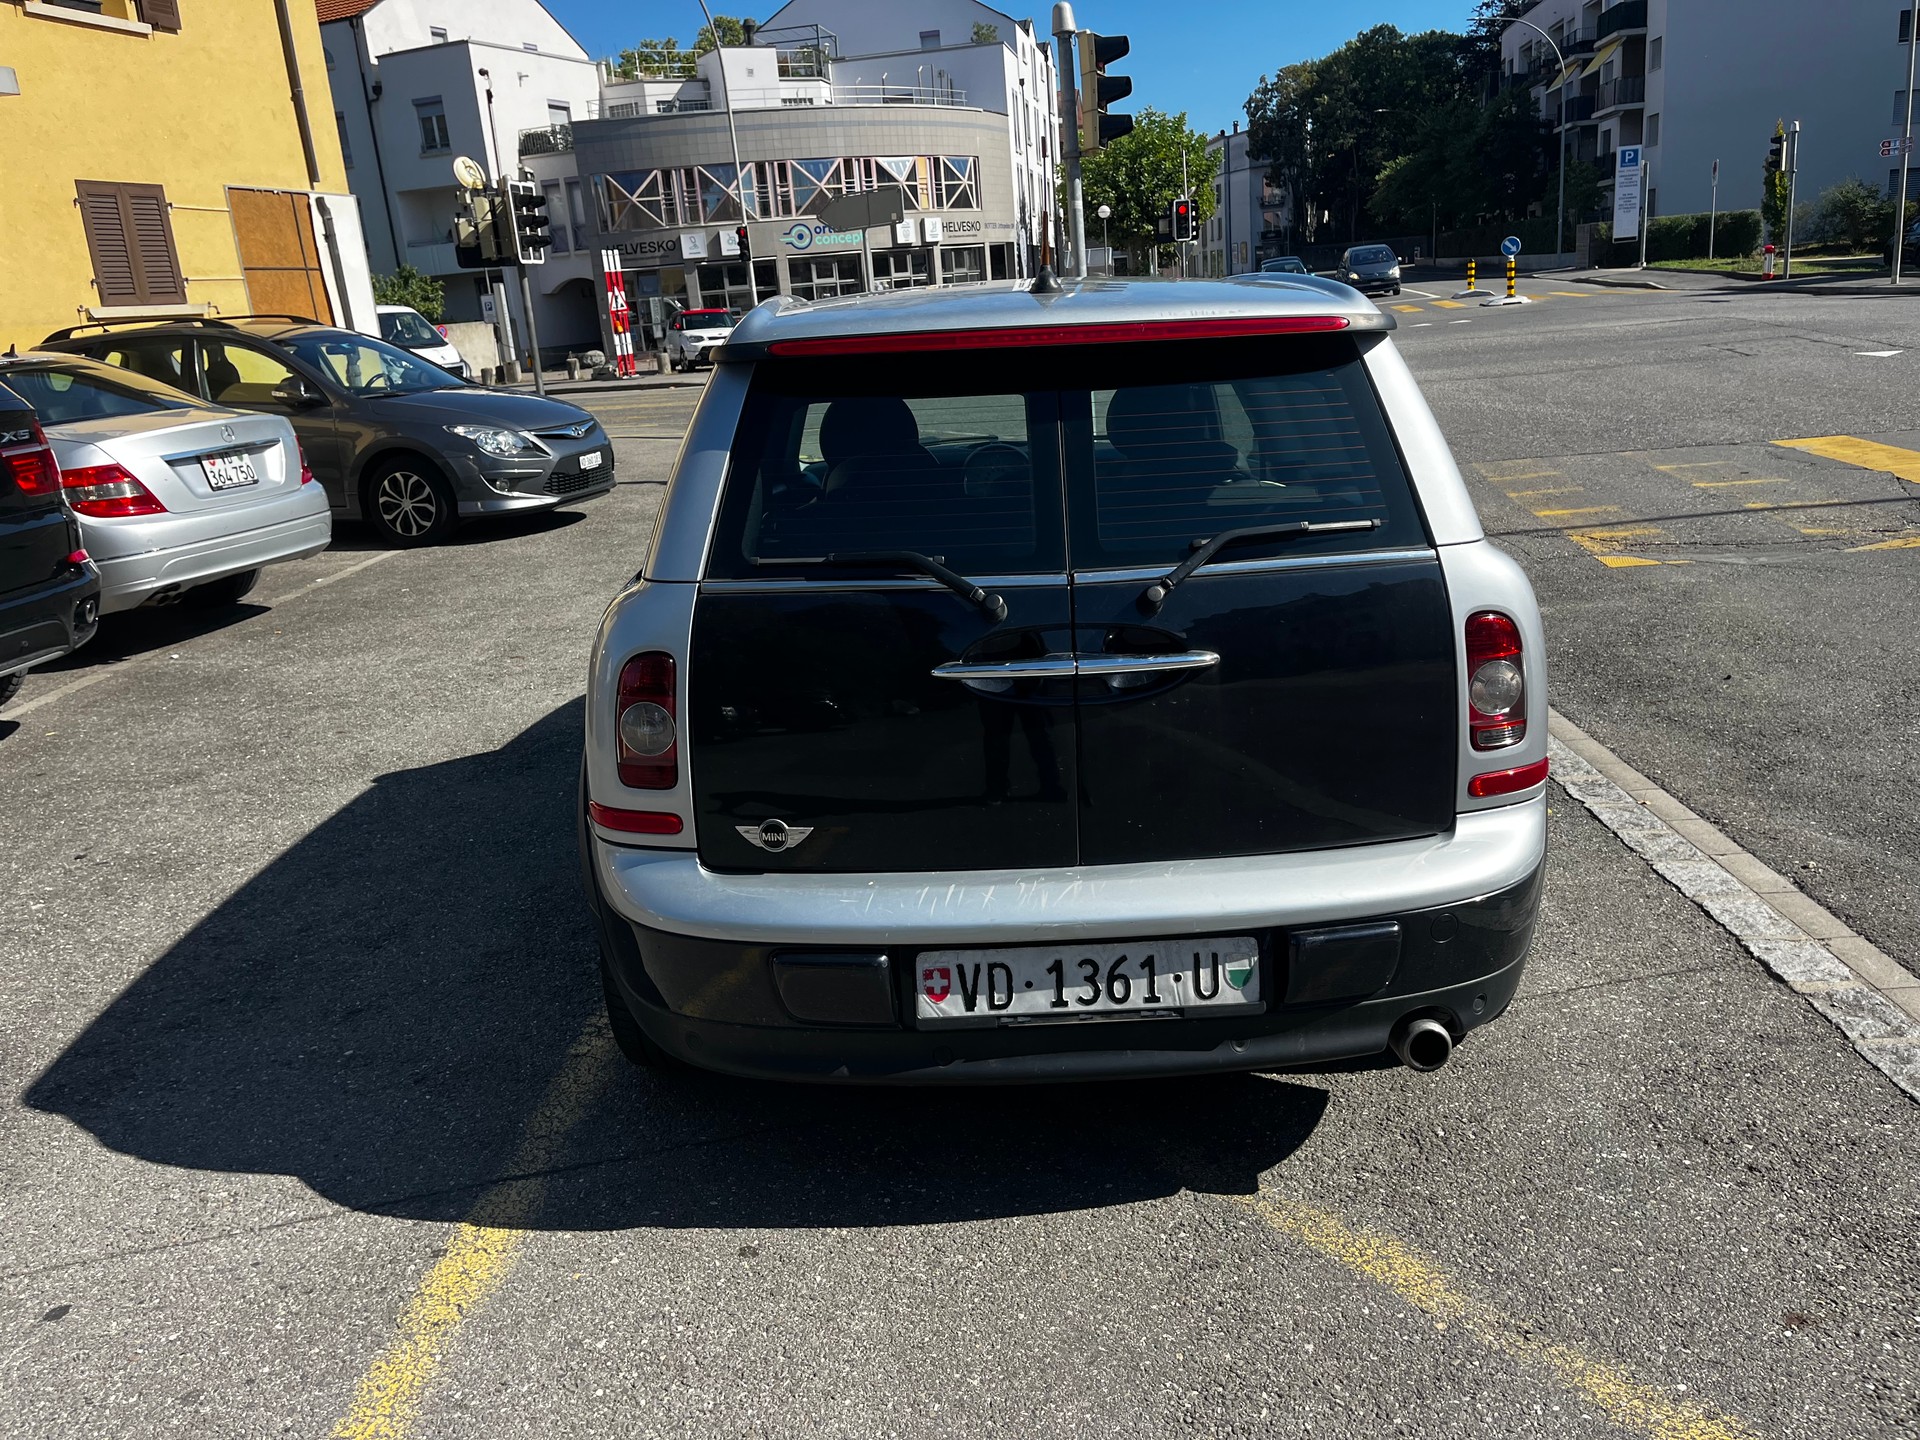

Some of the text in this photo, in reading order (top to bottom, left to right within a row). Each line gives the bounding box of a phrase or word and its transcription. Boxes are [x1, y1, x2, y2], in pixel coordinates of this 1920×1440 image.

[1625, 151, 1635, 163] P
[942, 221, 981, 232] HELVESKO
[0, 429, 30, 443] X5
[210, 465, 254, 485] 364 750
[762, 832, 786, 842] MINI
